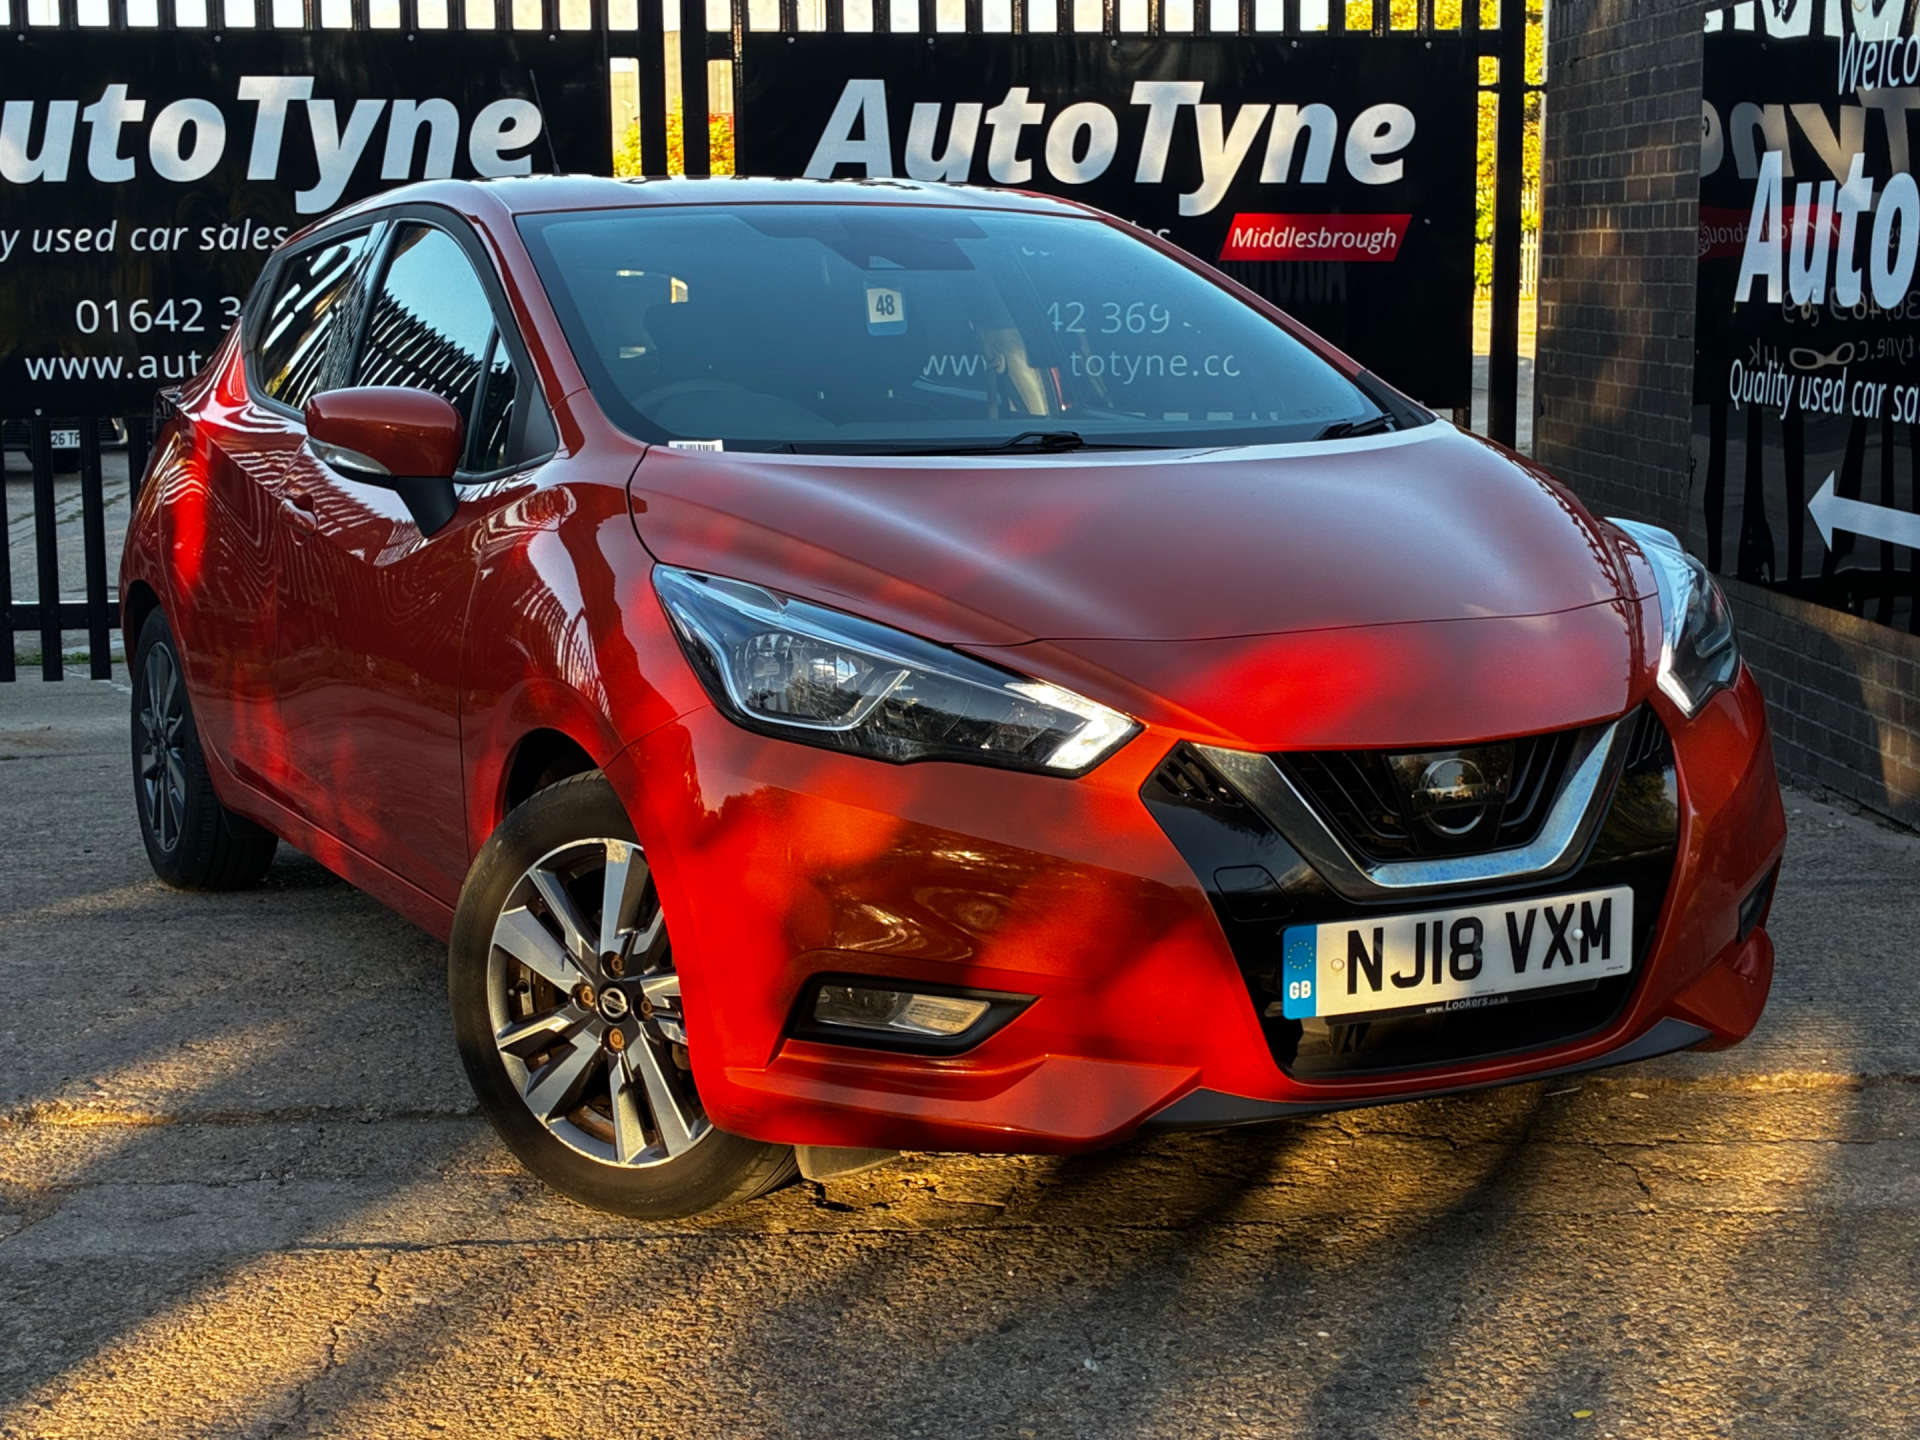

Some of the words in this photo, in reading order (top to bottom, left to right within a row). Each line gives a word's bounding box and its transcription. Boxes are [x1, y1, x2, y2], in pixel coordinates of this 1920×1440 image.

[1838, 20, 1920, 95] Welco
[802, 79, 1416, 217] AutoTyne
[32, 219, 118, 253] used
[130, 226, 188, 251] car
[200, 218, 288, 250] sales
[1231, 226, 1398, 255] Middlesbrough
[1734, 150, 1920, 309] Auto
[75, 298, 205, 334] 01642
[875, 294, 895, 317] 48
[25, 349, 212, 381] www.aut
[1729, 358, 1795, 420] Quality
[1799, 366, 1847, 415] used
[1851, 380, 1887, 419] car
[1288, 979, 1312, 1000] GB
[1346, 916, 1485, 995] NJ18
[1504, 897, 1613, 974] VXM
